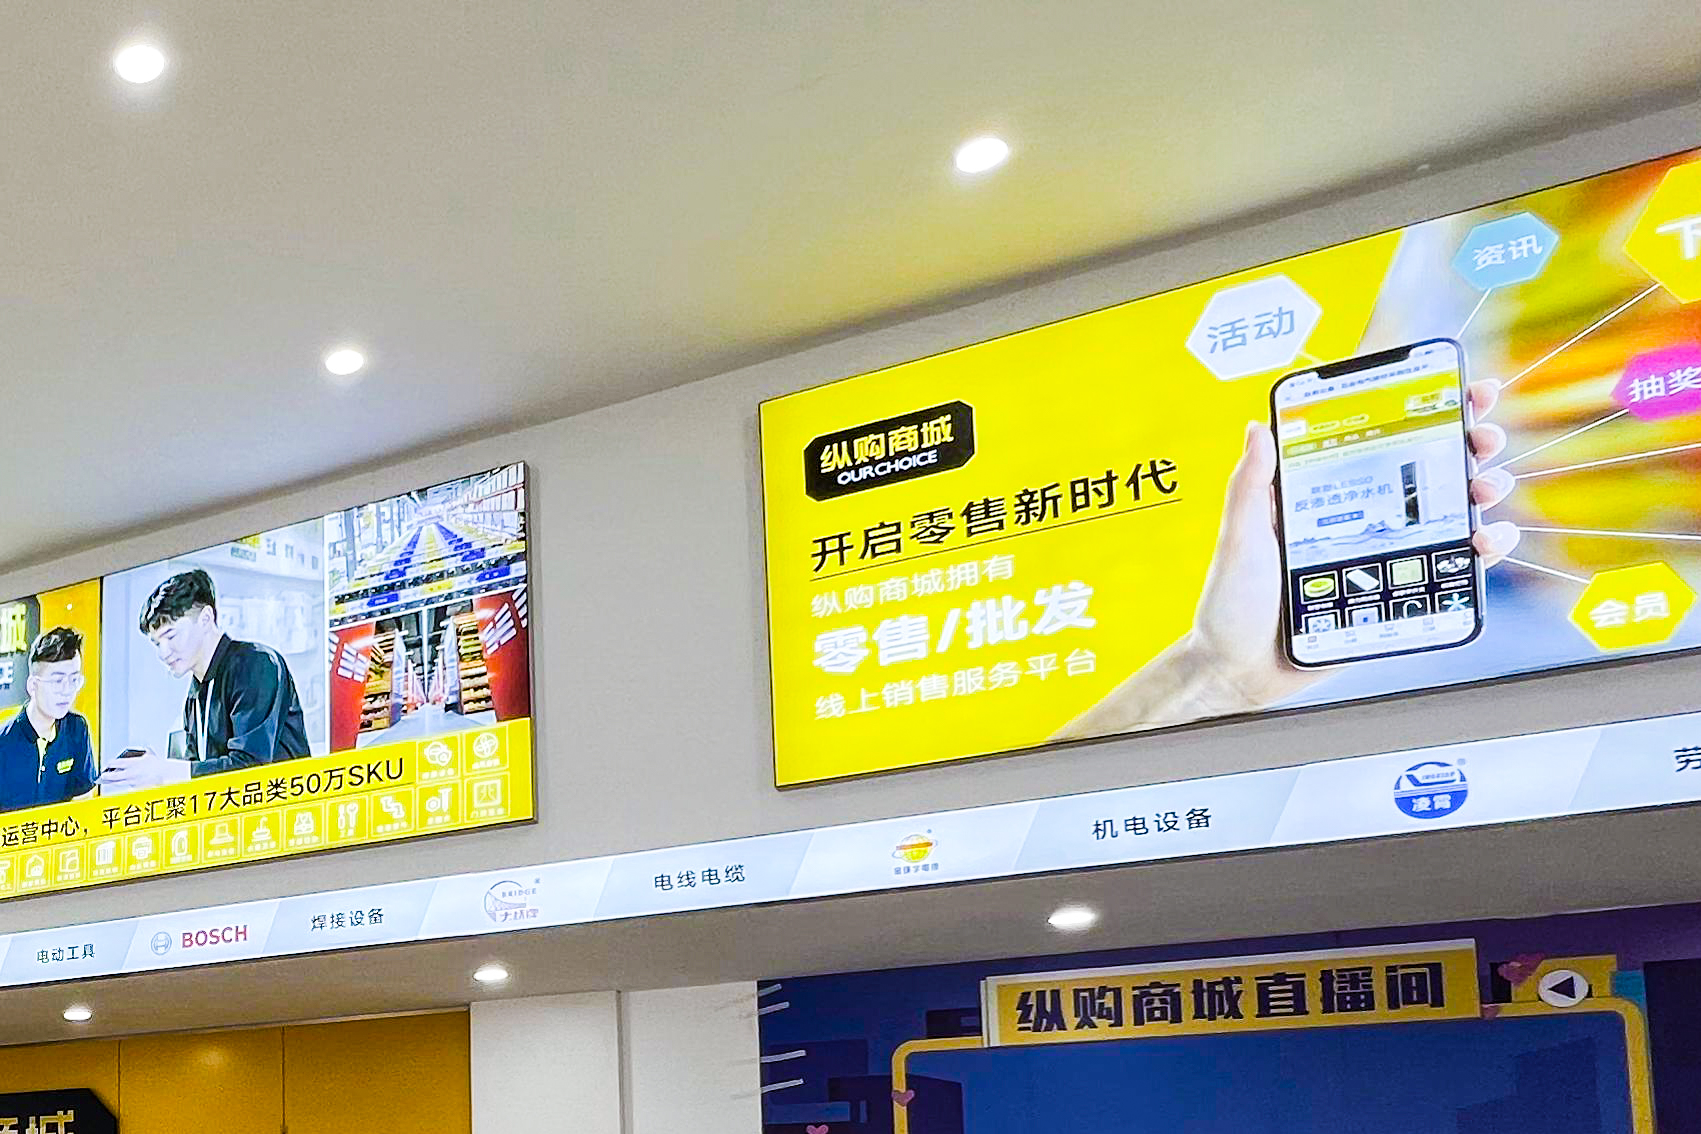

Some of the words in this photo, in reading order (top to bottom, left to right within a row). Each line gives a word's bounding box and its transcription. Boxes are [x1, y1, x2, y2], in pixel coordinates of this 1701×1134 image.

[1472, 233, 1544, 271] 资讯
[1207, 306, 1296, 354] 活动
[1628, 366, 1701, 404] 抽奖
[819, 414, 955, 475] 纵购商城
[811, 459, 1180, 573] 开启零售新时代
[811, 553, 1017, 620] 纵购商城拥有
[813, 580, 1098, 676] 零售/批发
[1589, 592, 1671, 629] 会员
[814, 648, 1098, 721] 线上销售服务平台
[1091, 807, 1213, 841] 机电设备
[654, 864, 746, 892] 电线电缆
[181, 925, 248, 949] BOSCH
[310, 908, 385, 931] 焊接设备
[36, 943, 96, 963] 电动工具
[1015, 959, 1446, 1036] 纵购商城直播间
